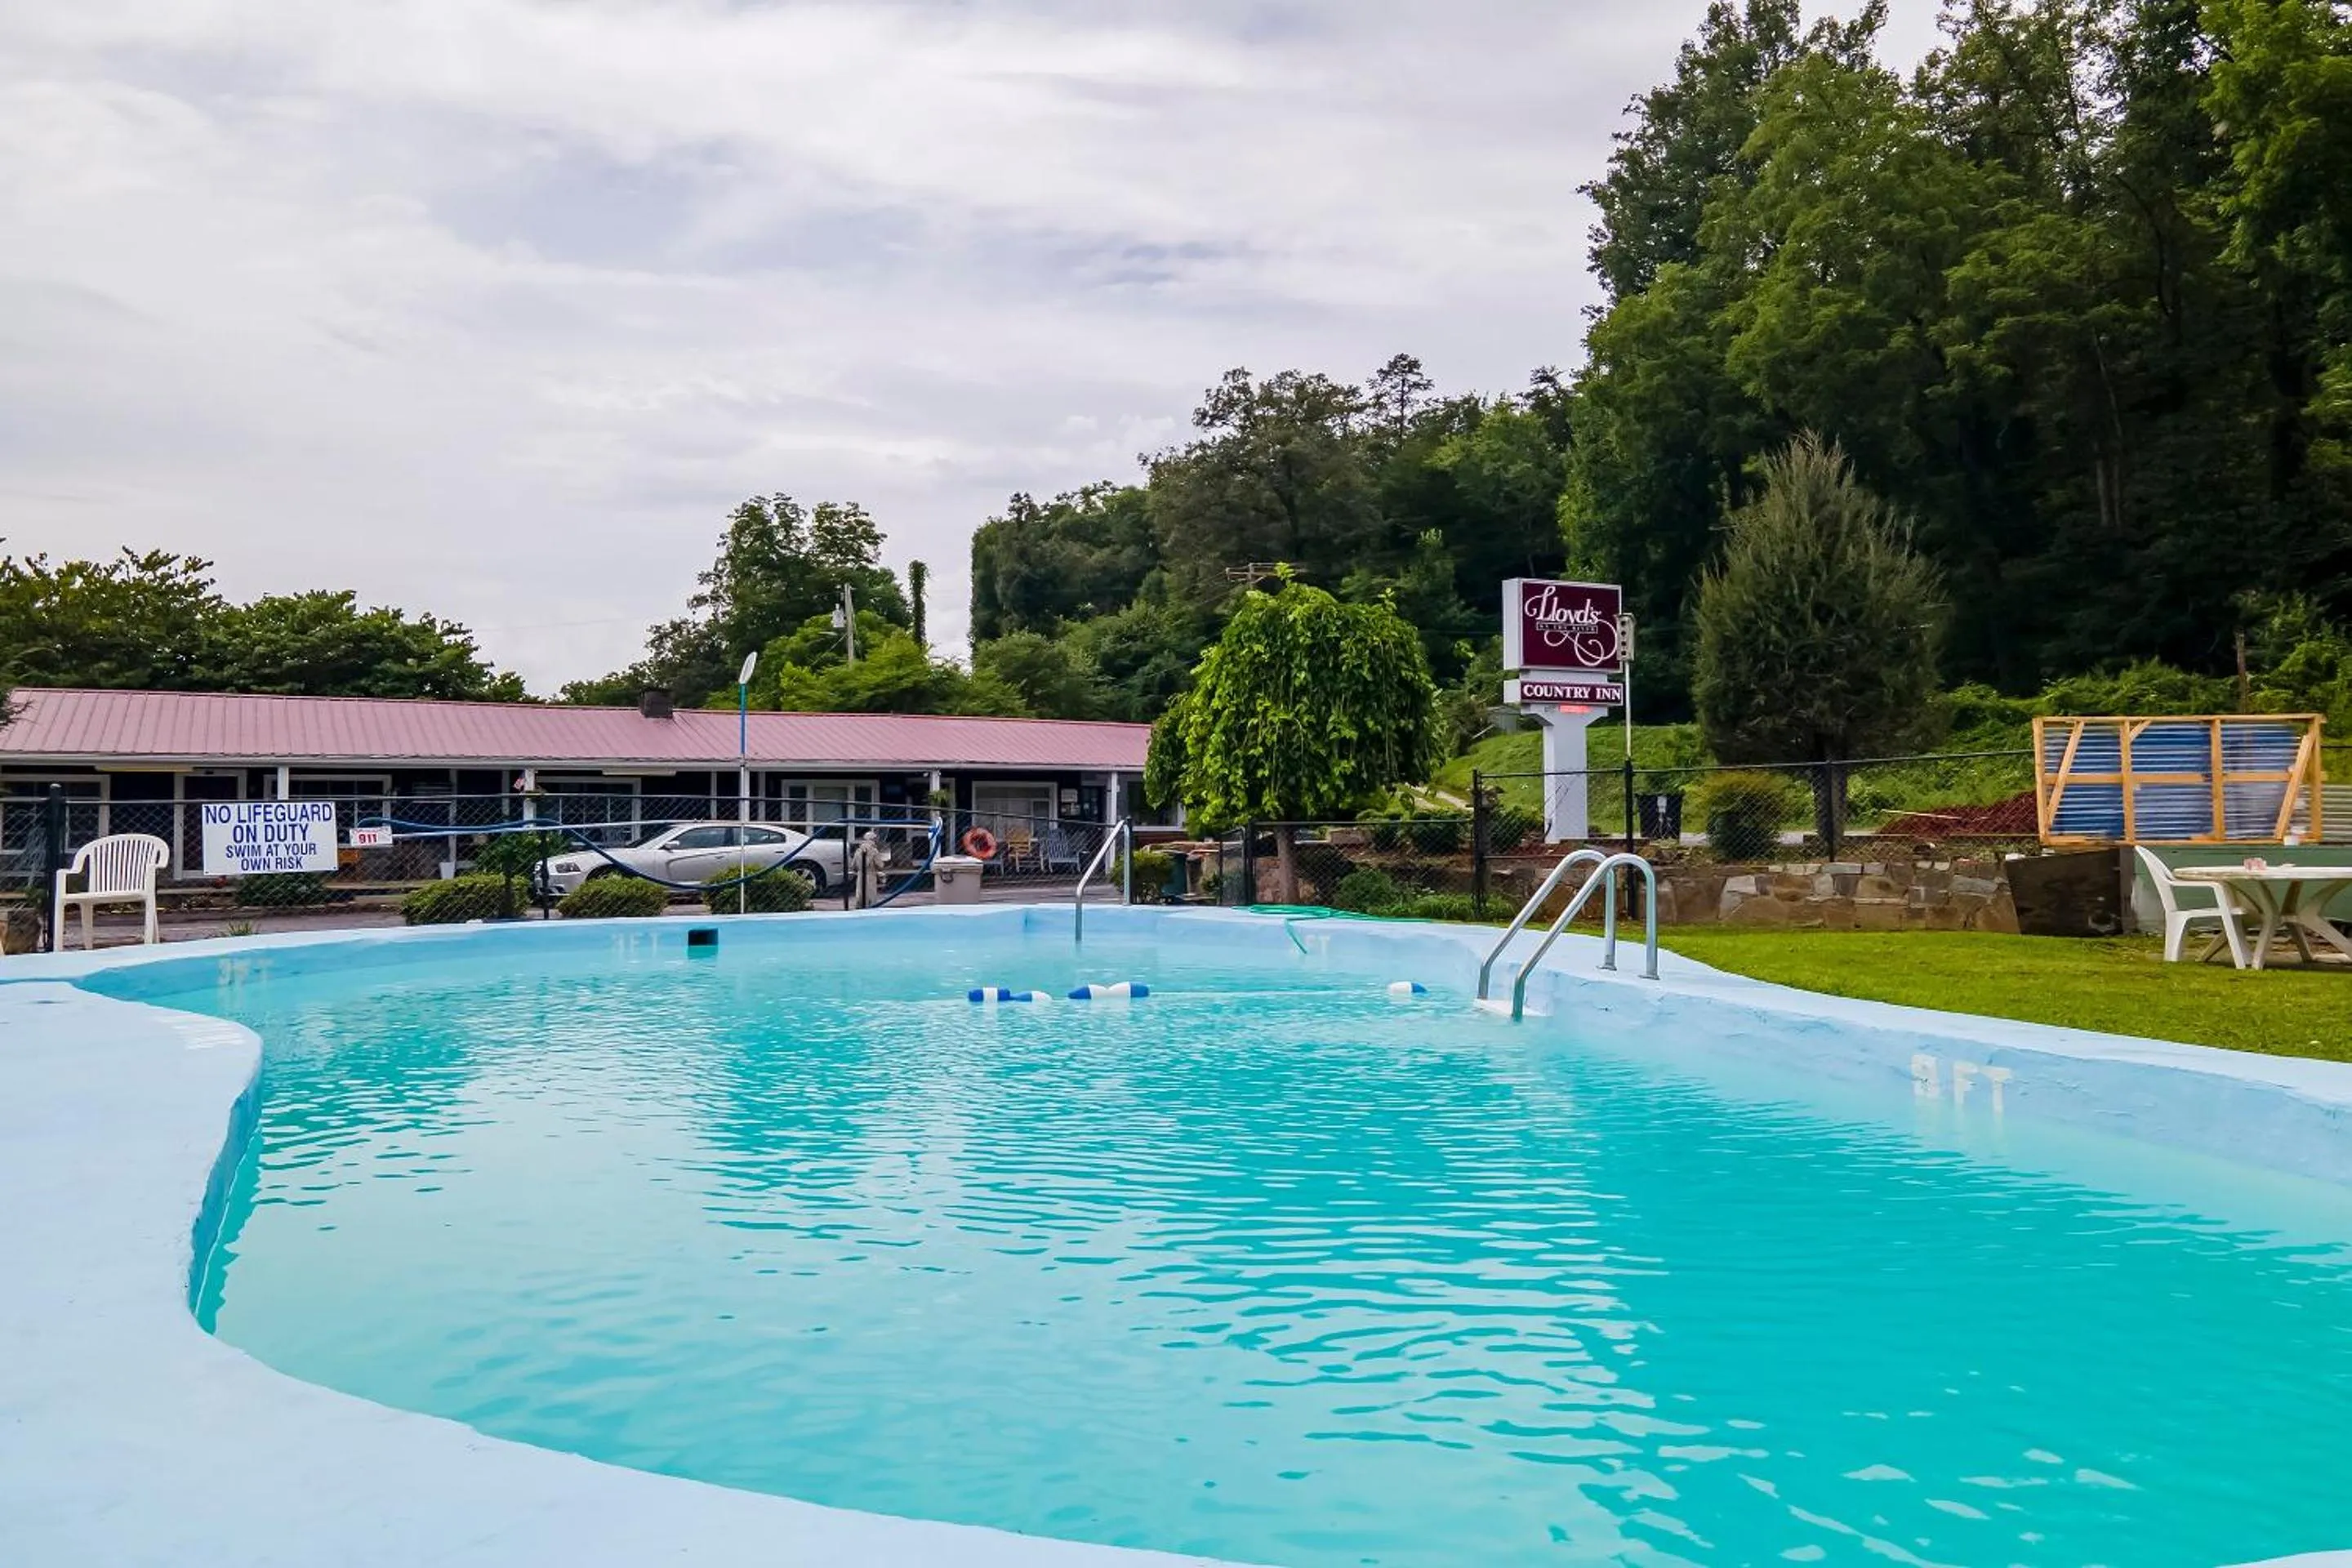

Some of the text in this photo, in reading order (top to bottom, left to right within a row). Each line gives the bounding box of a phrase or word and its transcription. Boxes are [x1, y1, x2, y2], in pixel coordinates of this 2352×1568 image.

[1525, 586, 1606, 633] Lloyd's
[1523, 684, 1621, 700] COUNTRY INN
[205, 804, 332, 824] NO LIFEGUARD
[233, 823, 309, 844] ON DUTY
[359, 834, 376, 844] 911
[225, 843, 317, 858] SWIM AT YOUR
[241, 857, 303, 871] OWN RISK
